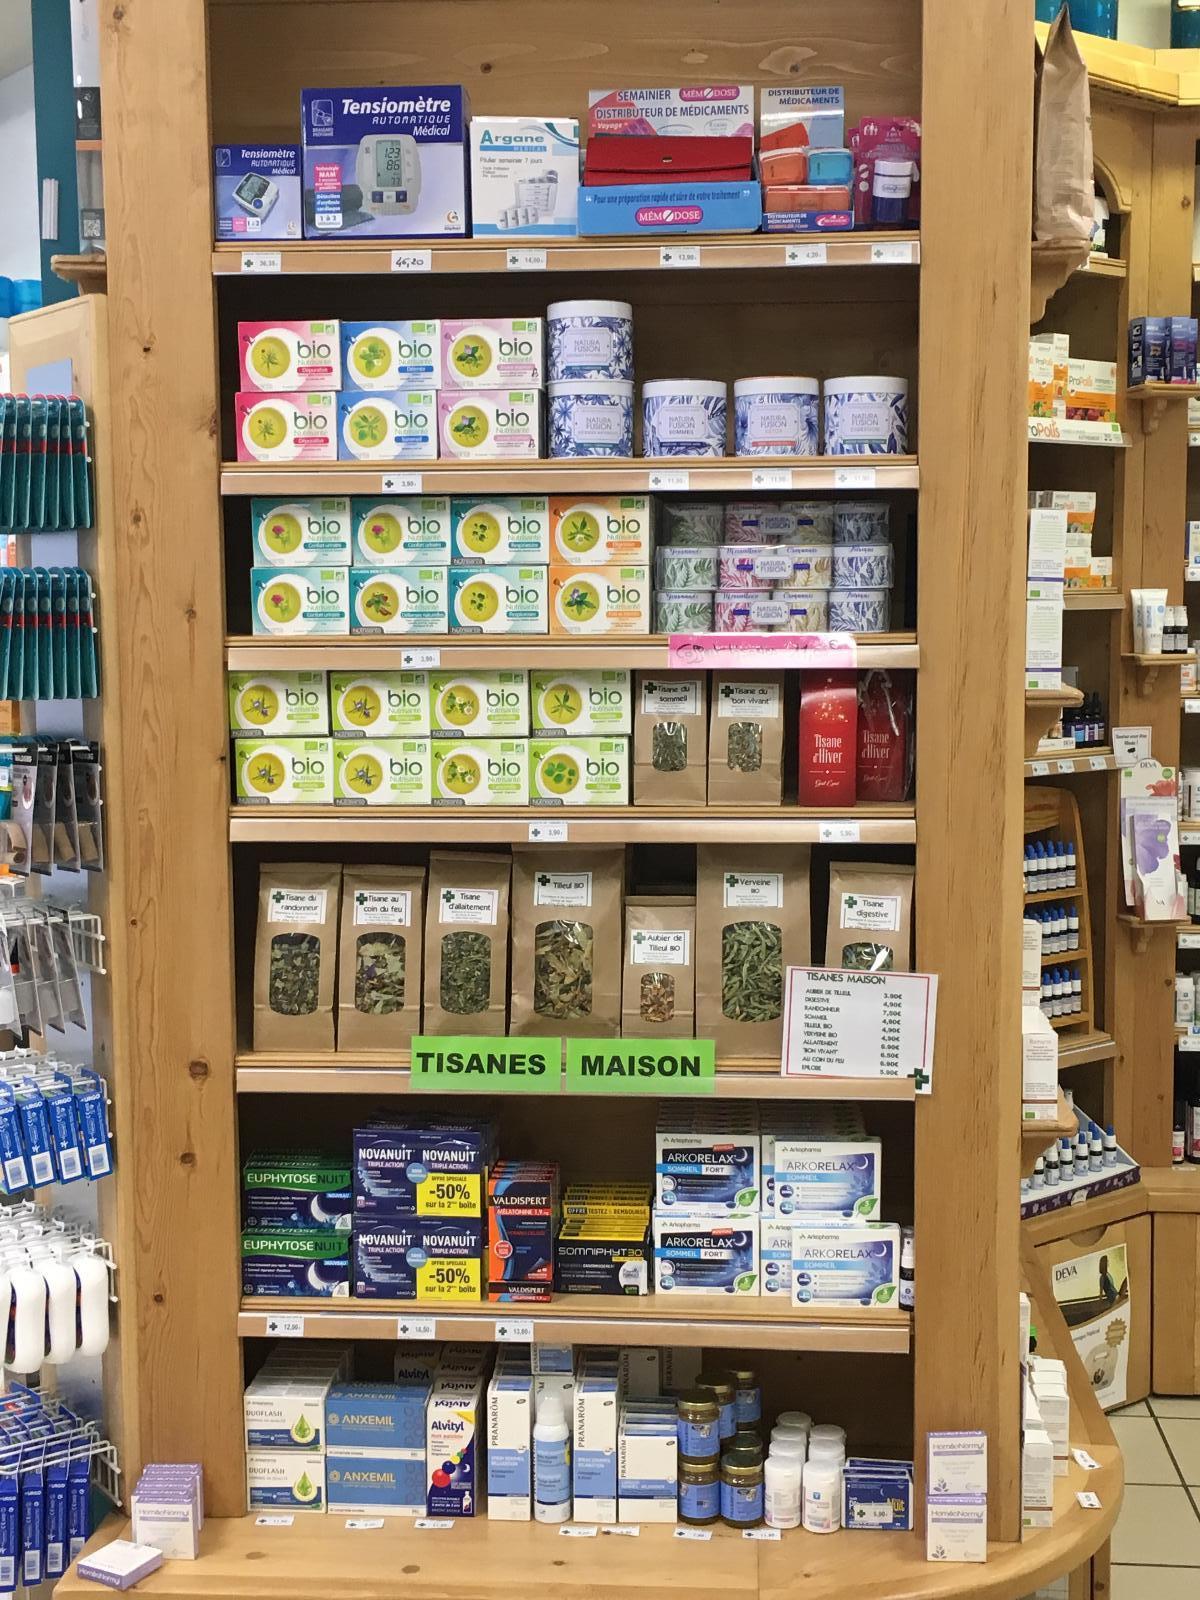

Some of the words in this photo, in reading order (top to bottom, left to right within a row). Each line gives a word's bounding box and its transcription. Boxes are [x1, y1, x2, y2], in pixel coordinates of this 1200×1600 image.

[617, 89, 671, 101] SEMAINIER
[768, 88, 828, 97] DISTRIBUTEUR
[342, 97, 450, 115] Tensiomètre
[779, 96, 840, 105] MÉDICAMENTS
[596, 107, 664, 120] DISTRIBUTEUR
[665, 107, 678, 117] DE
[680, 104, 749, 117] MÉDICAMENTS
[373, 114, 450, 125] AUTOMATIQUE
[413, 125, 450, 136] Médical
[480, 129, 544, 145] Argane
[241, 150, 295, 159] Tensiomètre
[385, 148, 400, 158] 123
[251, 159, 295, 167] AUTOMATIQUE
[272, 167, 295, 175] Médical
[297, 340, 331, 359] bio
[398, 340, 432, 358] bio
[499, 338, 533, 356] bio
[294, 411, 327, 429] bio
[394, 410, 428, 428] bio
[496, 408, 529, 427] bio
[308, 516, 341, 535] bio
[408, 516, 441, 534] bio
[508, 516, 540, 534] bio
[607, 516, 640, 534] bio
[307, 586, 340, 604] bio
[406, 586, 439, 604] bio
[506, 586, 539, 603] bio
[607, 585, 640, 603] bio
[658, 685, 679, 693] Tisane
[681, 685, 690, 693] du
[735, 687, 756, 695] Tisane
[286, 689, 318, 706] bio
[388, 689, 420, 707] bio
[486, 689, 519, 706] bio
[589, 688, 622, 705] bio
[659, 694, 688, 702] sommeil
[815, 733, 842, 748] Tisane
[863, 730, 889, 744] Tisane
[292, 757, 324, 775] bio
[390, 758, 422, 775] bio
[487, 758, 520, 776] bio
[586, 758, 619, 775] bio
[553, 881, 572, 889] Tilleul
[740, 878, 771, 886] Verveine
[286, 894, 306, 902] Tisane
[308, 894, 316, 902] du
[460, 893, 480, 901] Tisane
[281, 903, 318, 911] randonneur
[390, 905, 402, 913] feu
[449, 903, 490, 911] d'allaitement
[862, 900, 884, 908] Tisane
[856, 910, 888, 918] digestive
[649, 944, 668, 952] Tilleul
[806, 972, 843, 982] TISANES
[847, 975, 886, 985] MAISON
[416, 1052, 546, 1075] TISANES
[581, 1055, 700, 1077] MAISON
[359, 1147, 412, 1160] NOVANUIT
[423, 1149, 476, 1162] NOVANUIT
[667, 1153, 734, 1163] ARKORELAX
[787, 1161, 855, 1171] ARKORELAX
[429, 1184, 470, 1200] -50%
[459, 1201, 476, 1209] boîte
[493, 1196, 547, 1206] VALDISPERT
[359, 1232, 412, 1246] NOVANUIT
[423, 1234, 476, 1247] NOVANUIT
[666, 1237, 734, 1247] ARKORELAX
[804, 1249, 872, 1259] ARKORELAX
[429, 1269, 470, 1284] -50%
[1055, 1266, 1078, 1281] DEVA
[439, 1285, 446, 1293] la
[459, 1285, 476, 1293] boîte
[399, 1369, 430, 1380] Alvityl
[342, 1415, 395, 1426] ANXEMIL
[431, 1420, 465, 1432] Alvityl
[491, 1396, 499, 1446] PRANARÔM
[249, 1467, 285, 1475] DUOFLASH
[343, 1472, 396, 1483] ANXEMIL
